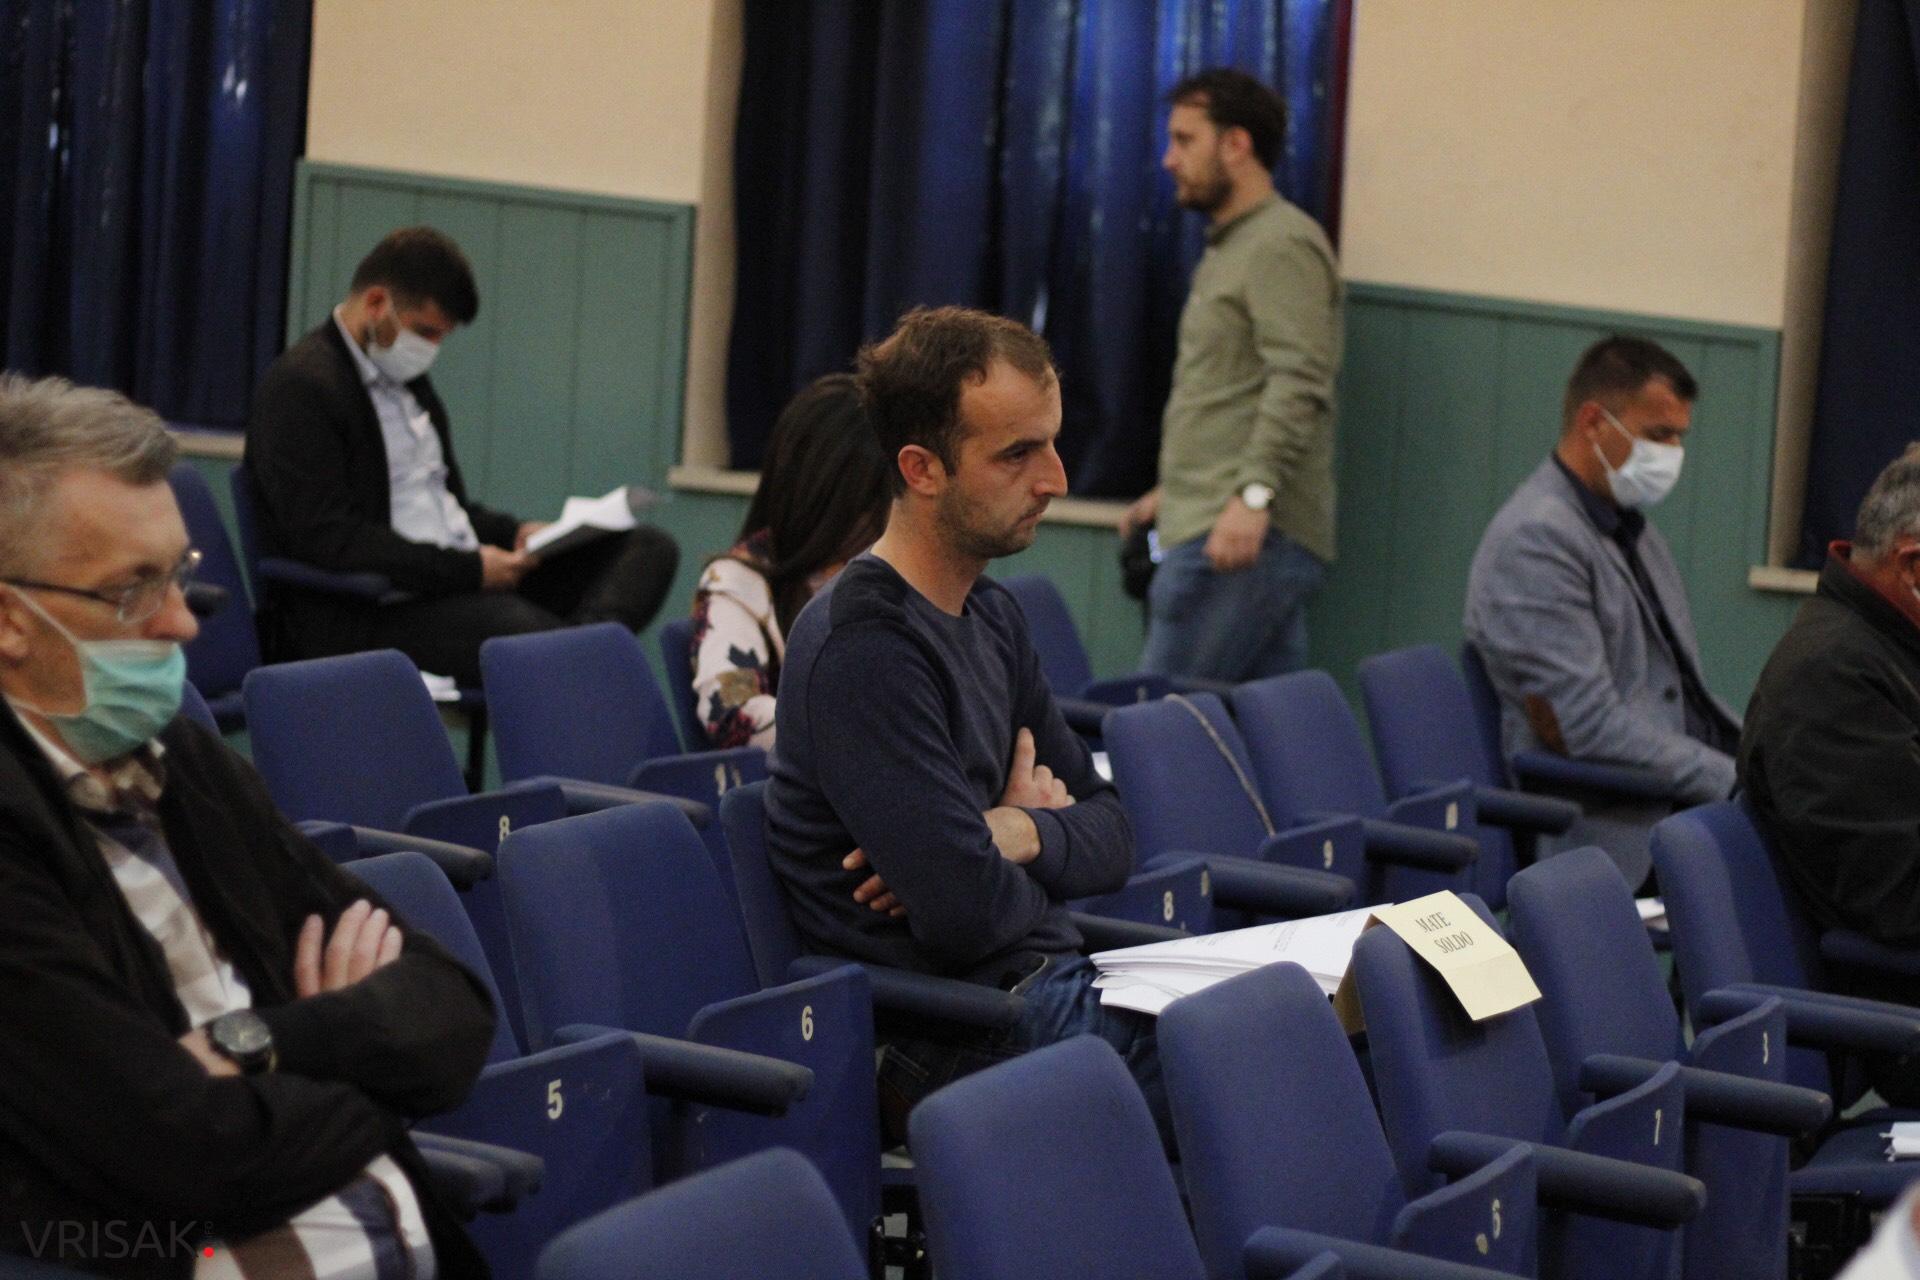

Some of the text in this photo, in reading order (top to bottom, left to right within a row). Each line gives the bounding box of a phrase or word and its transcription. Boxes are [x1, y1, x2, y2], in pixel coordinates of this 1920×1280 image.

[498, 814, 511, 842] 8
[1162, 890, 1174, 922] 8
[1414, 910, 1452, 934] MATE
[1433, 929, 1475, 955] SOLDO
[800, 1004, 815, 1041] 6
[546, 1078, 563, 1120] 5
